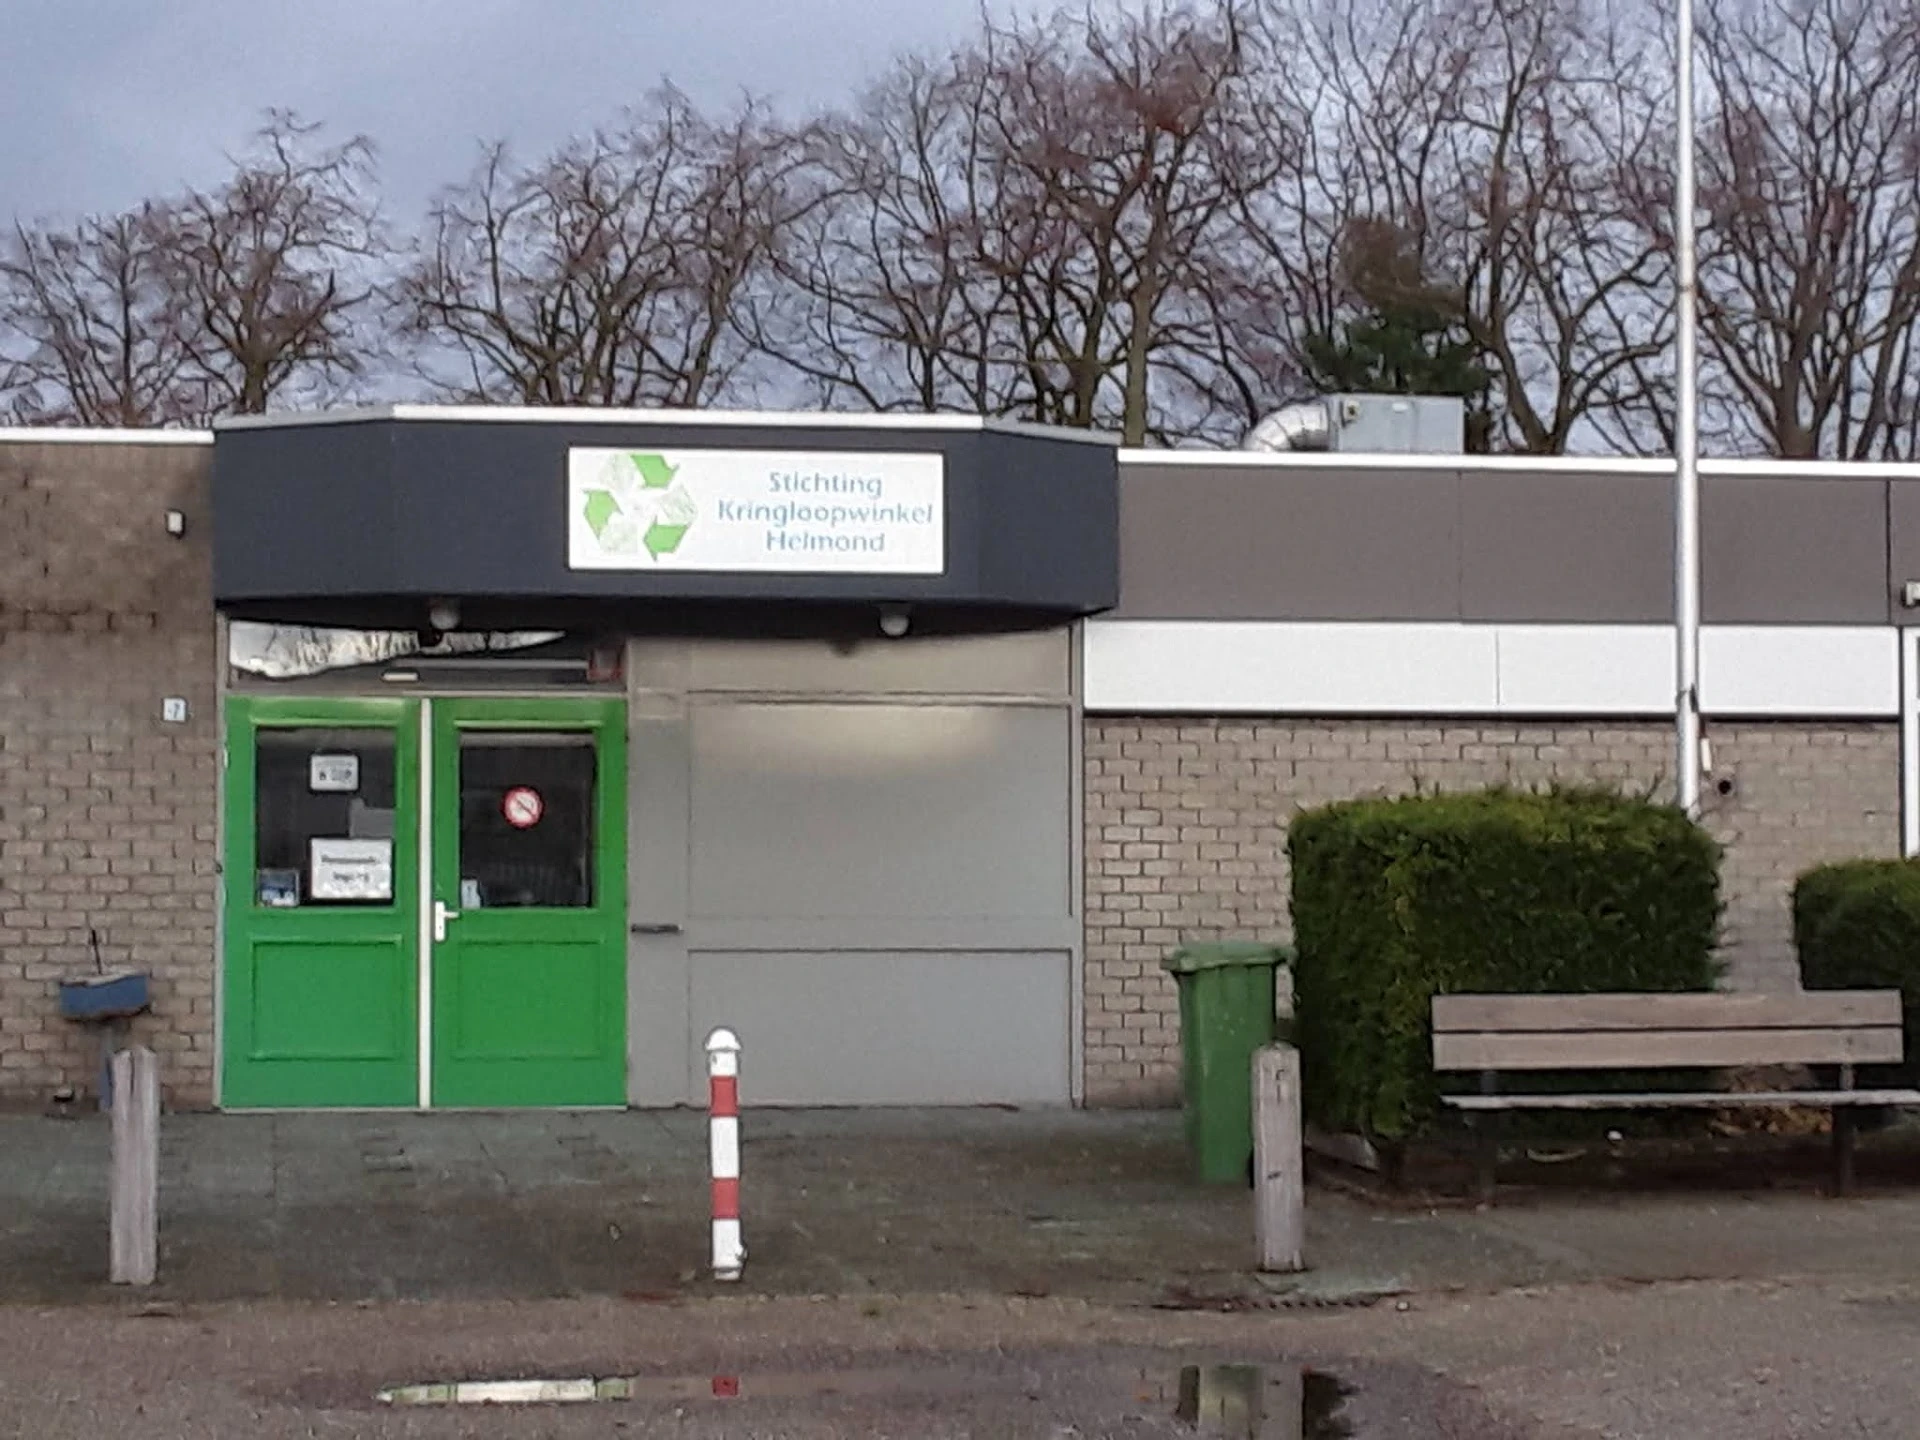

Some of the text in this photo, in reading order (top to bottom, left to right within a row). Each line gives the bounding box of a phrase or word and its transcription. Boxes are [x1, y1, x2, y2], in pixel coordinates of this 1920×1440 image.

[768, 470, 882, 499] Stichting
[718, 500, 933, 528] Kringloopwinkel
[766, 530, 886, 552] Helmond
